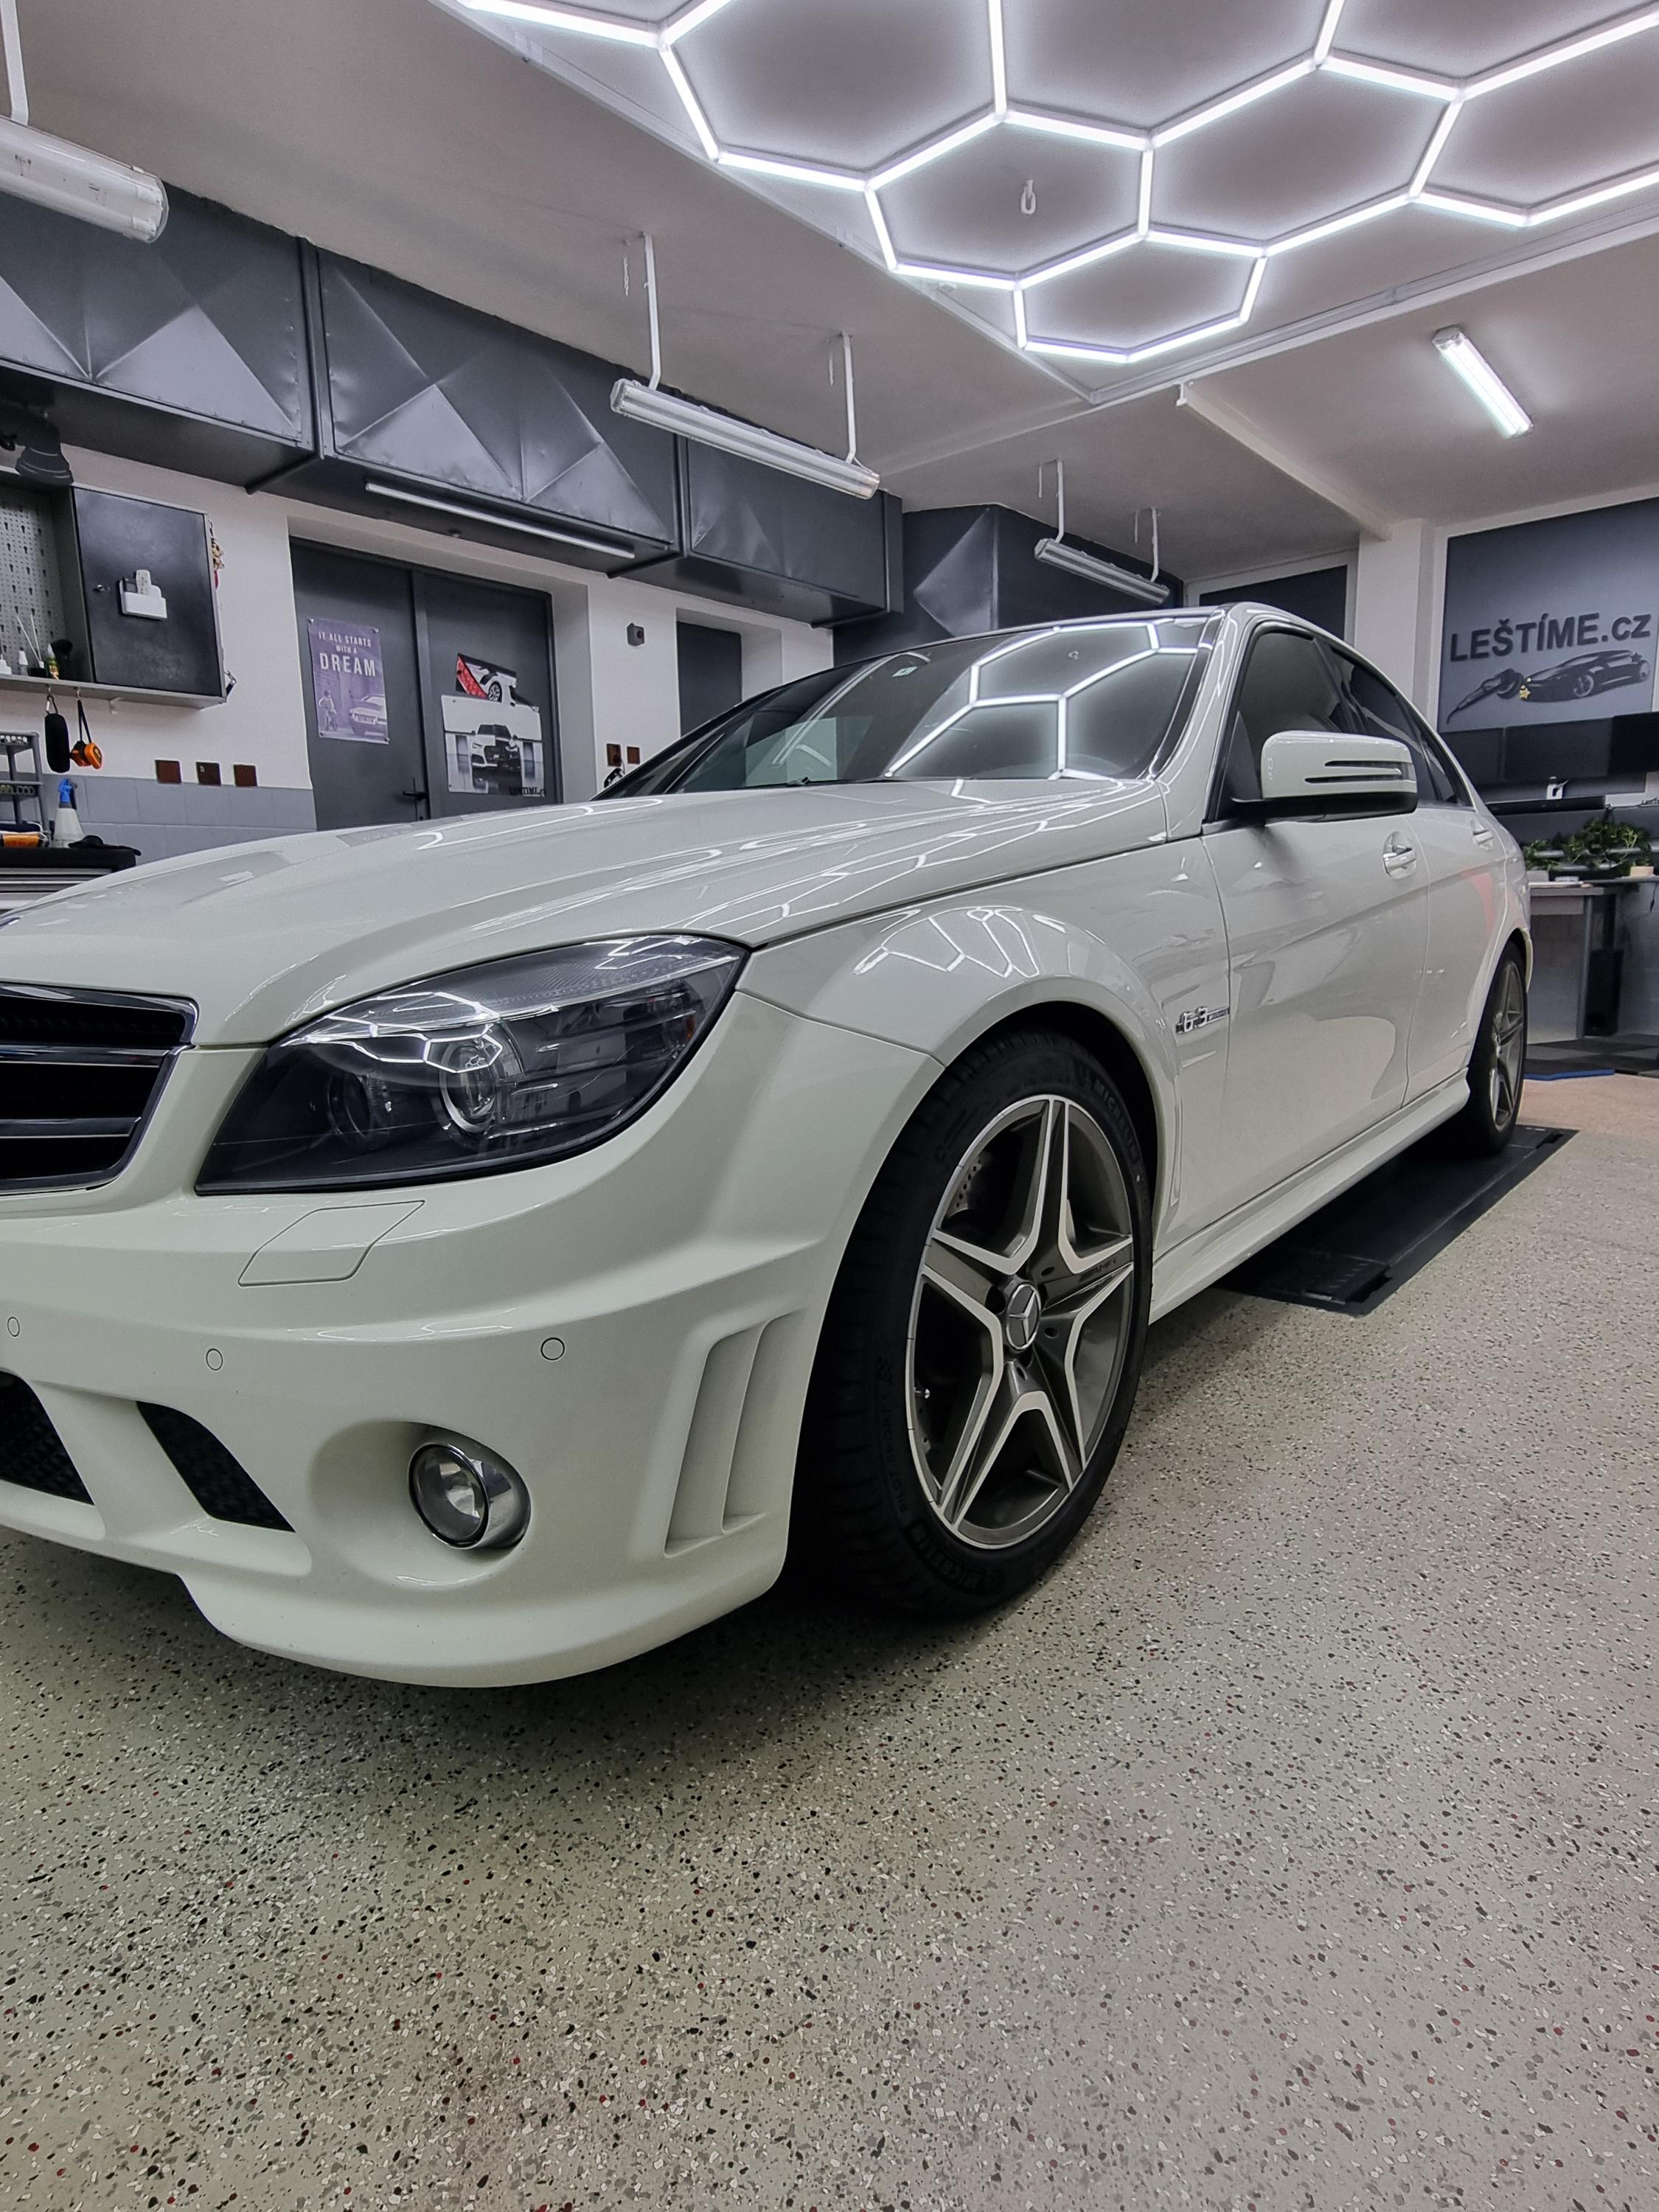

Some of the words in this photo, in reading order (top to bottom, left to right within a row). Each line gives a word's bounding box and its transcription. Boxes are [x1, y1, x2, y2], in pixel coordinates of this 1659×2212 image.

[318, 630, 327, 641] IT
[329, 633, 343, 643] ALL
[344, 635, 372, 648] STARTS
[1450, 613, 1652, 662] LEŠTÍME.CZ
[335, 644, 352, 654] WITH
[319, 652, 376, 678] DREAM
